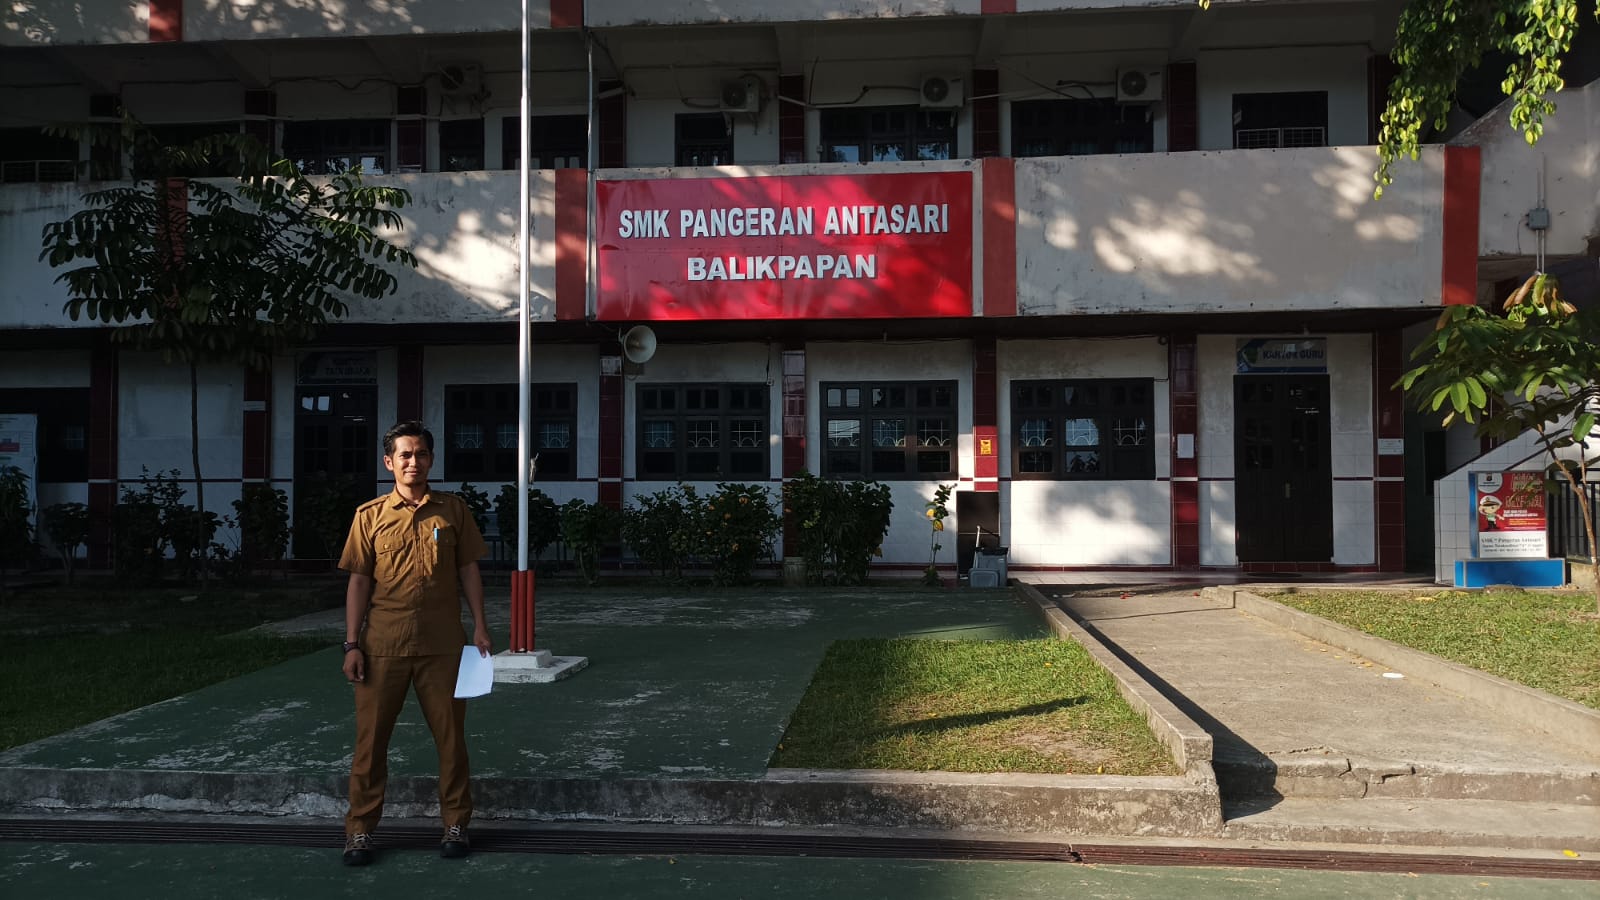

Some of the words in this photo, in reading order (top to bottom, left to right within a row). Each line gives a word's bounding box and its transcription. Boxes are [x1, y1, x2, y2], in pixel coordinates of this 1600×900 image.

[618, 209, 670, 239] SMK
[680, 206, 813, 238] PANGERAN
[823, 203, 949, 236] ANTASARI
[687, 254, 876, 281] BALIKPAPAN
[1299, 349, 1324, 360] GURU
